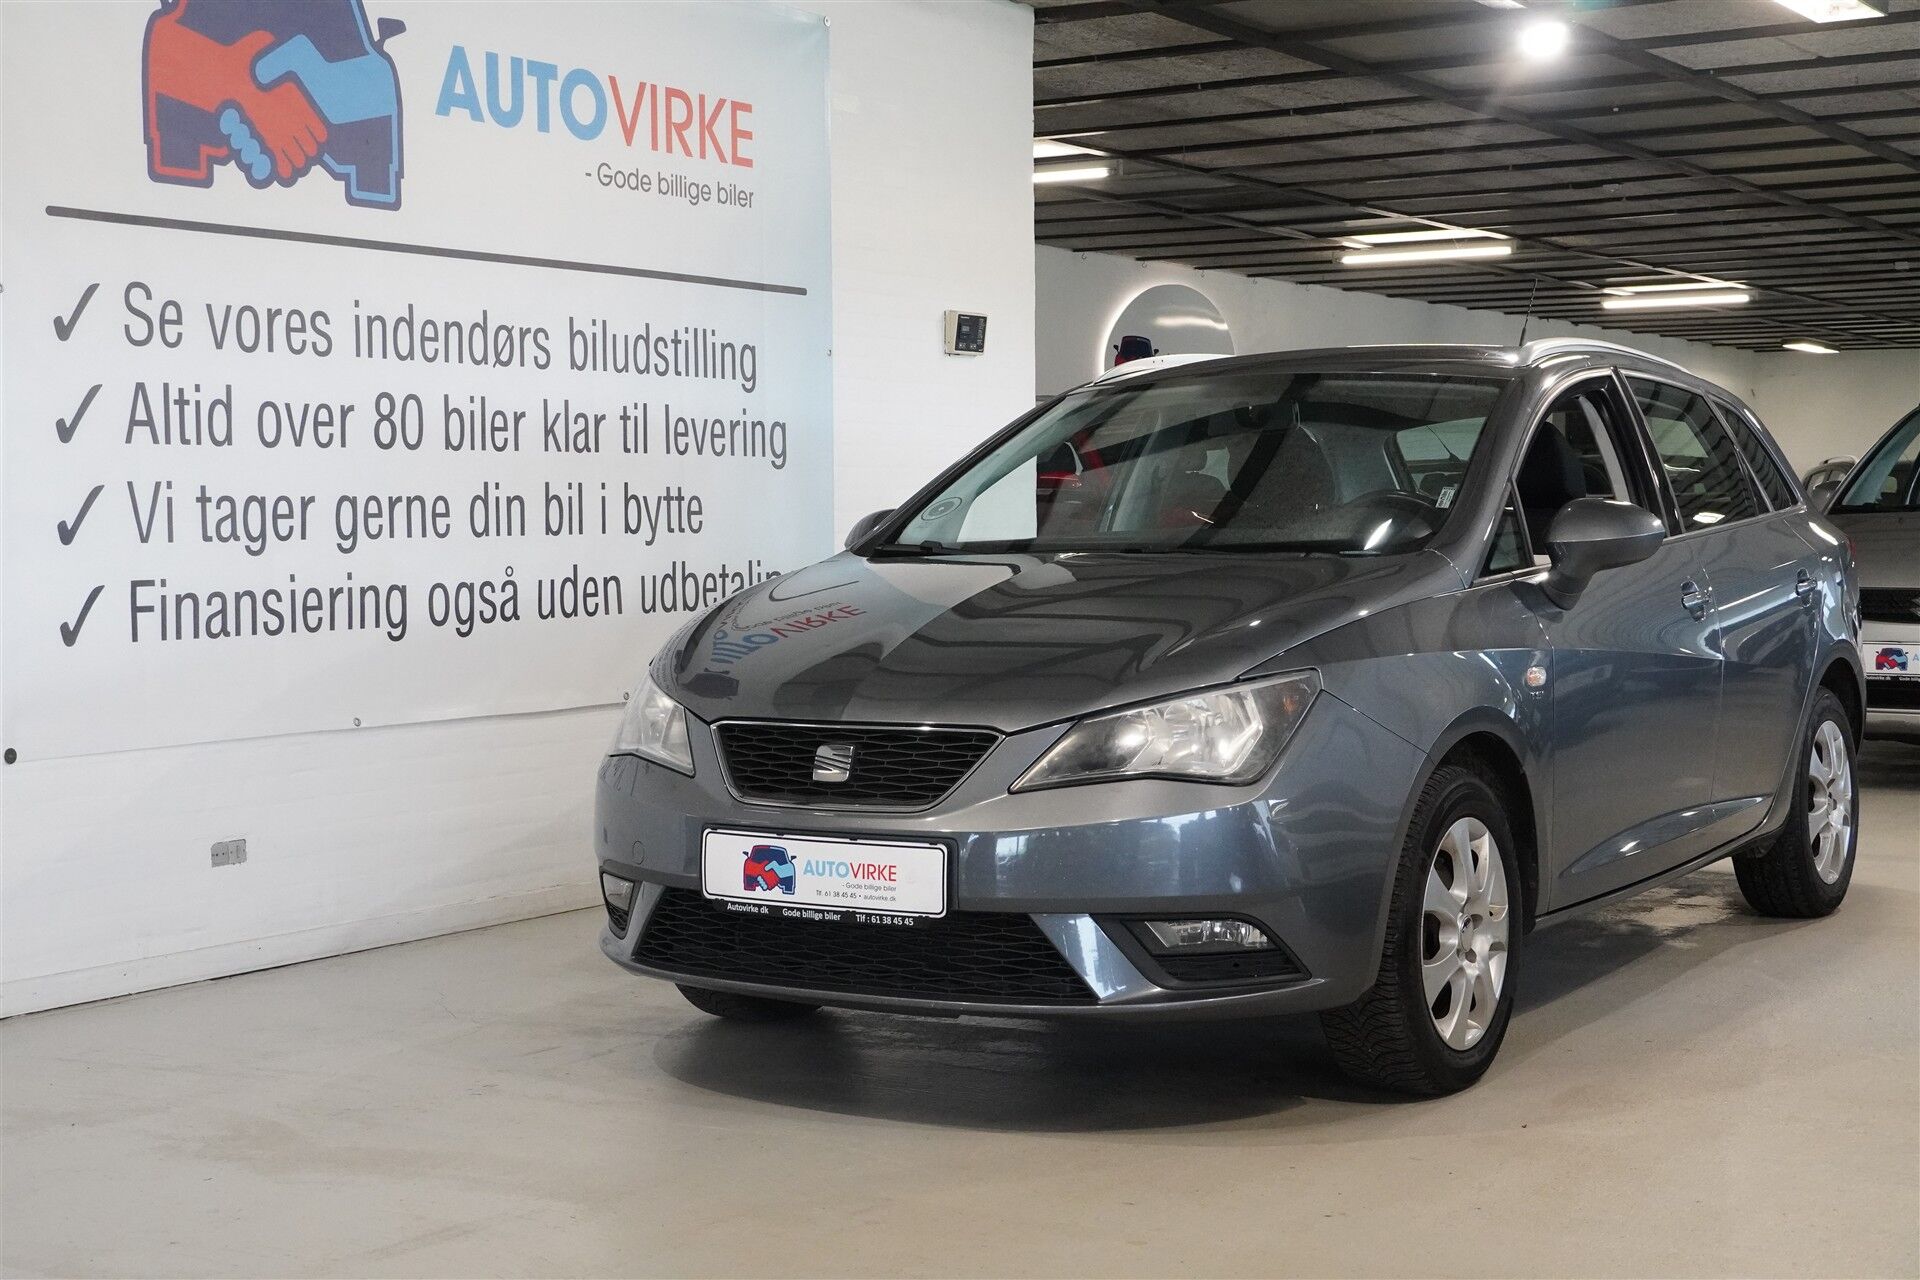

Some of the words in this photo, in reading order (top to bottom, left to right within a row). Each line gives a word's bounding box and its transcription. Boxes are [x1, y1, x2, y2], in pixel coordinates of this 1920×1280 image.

[437, 47, 753, 167] AUTOVIRKE
[597, 162, 651, 192] Gode
[657, 172, 712, 206] billige
[717, 181, 754, 208] biler
[124, 281, 183, 349] Se
[205, 303, 333, 358] vores
[354, 299, 551, 370] indendørs
[569, 316, 757, 394] biludstilling
[125, 382, 233, 447] Altid
[257, 400, 355, 449] over
[373, 391, 424, 451] 80
[443, 393, 526, 453] biler
[543, 398, 607, 454] klar
[619, 405, 648, 455] til
[664, 404, 787, 470] levering
[126, 480, 174, 544] Vi
[195, 485, 316, 557] tager
[335, 494, 451, 555] gerne
[469, 481, 526, 539] din
[544, 481, 584, 537] bil
[600, 482, 607, 535] i
[623, 481, 703, 547] bytte
[130, 573, 408, 643] Finansiering
[428, 565, 521, 638] også
[537, 563, 623, 621] uden
[803, 859, 897, 882] AUTOVIRKE
[833, 890, 840, 898] 38
[845, 882, 863, 890] Gode
[864, 883, 882, 893] billige
[727, 902, 759, 913] Autovirke
[782, 908, 801, 917] Gode
[802, 909, 823, 921] billige
[824, 911, 841, 921] biler
[855, 914, 866, 922] Tlf
[871, 915, 880, 924] 61
[882, 916, 892, 925] 38
[893, 916, 903, 926] 45
[904, 917, 914, 926] 45
